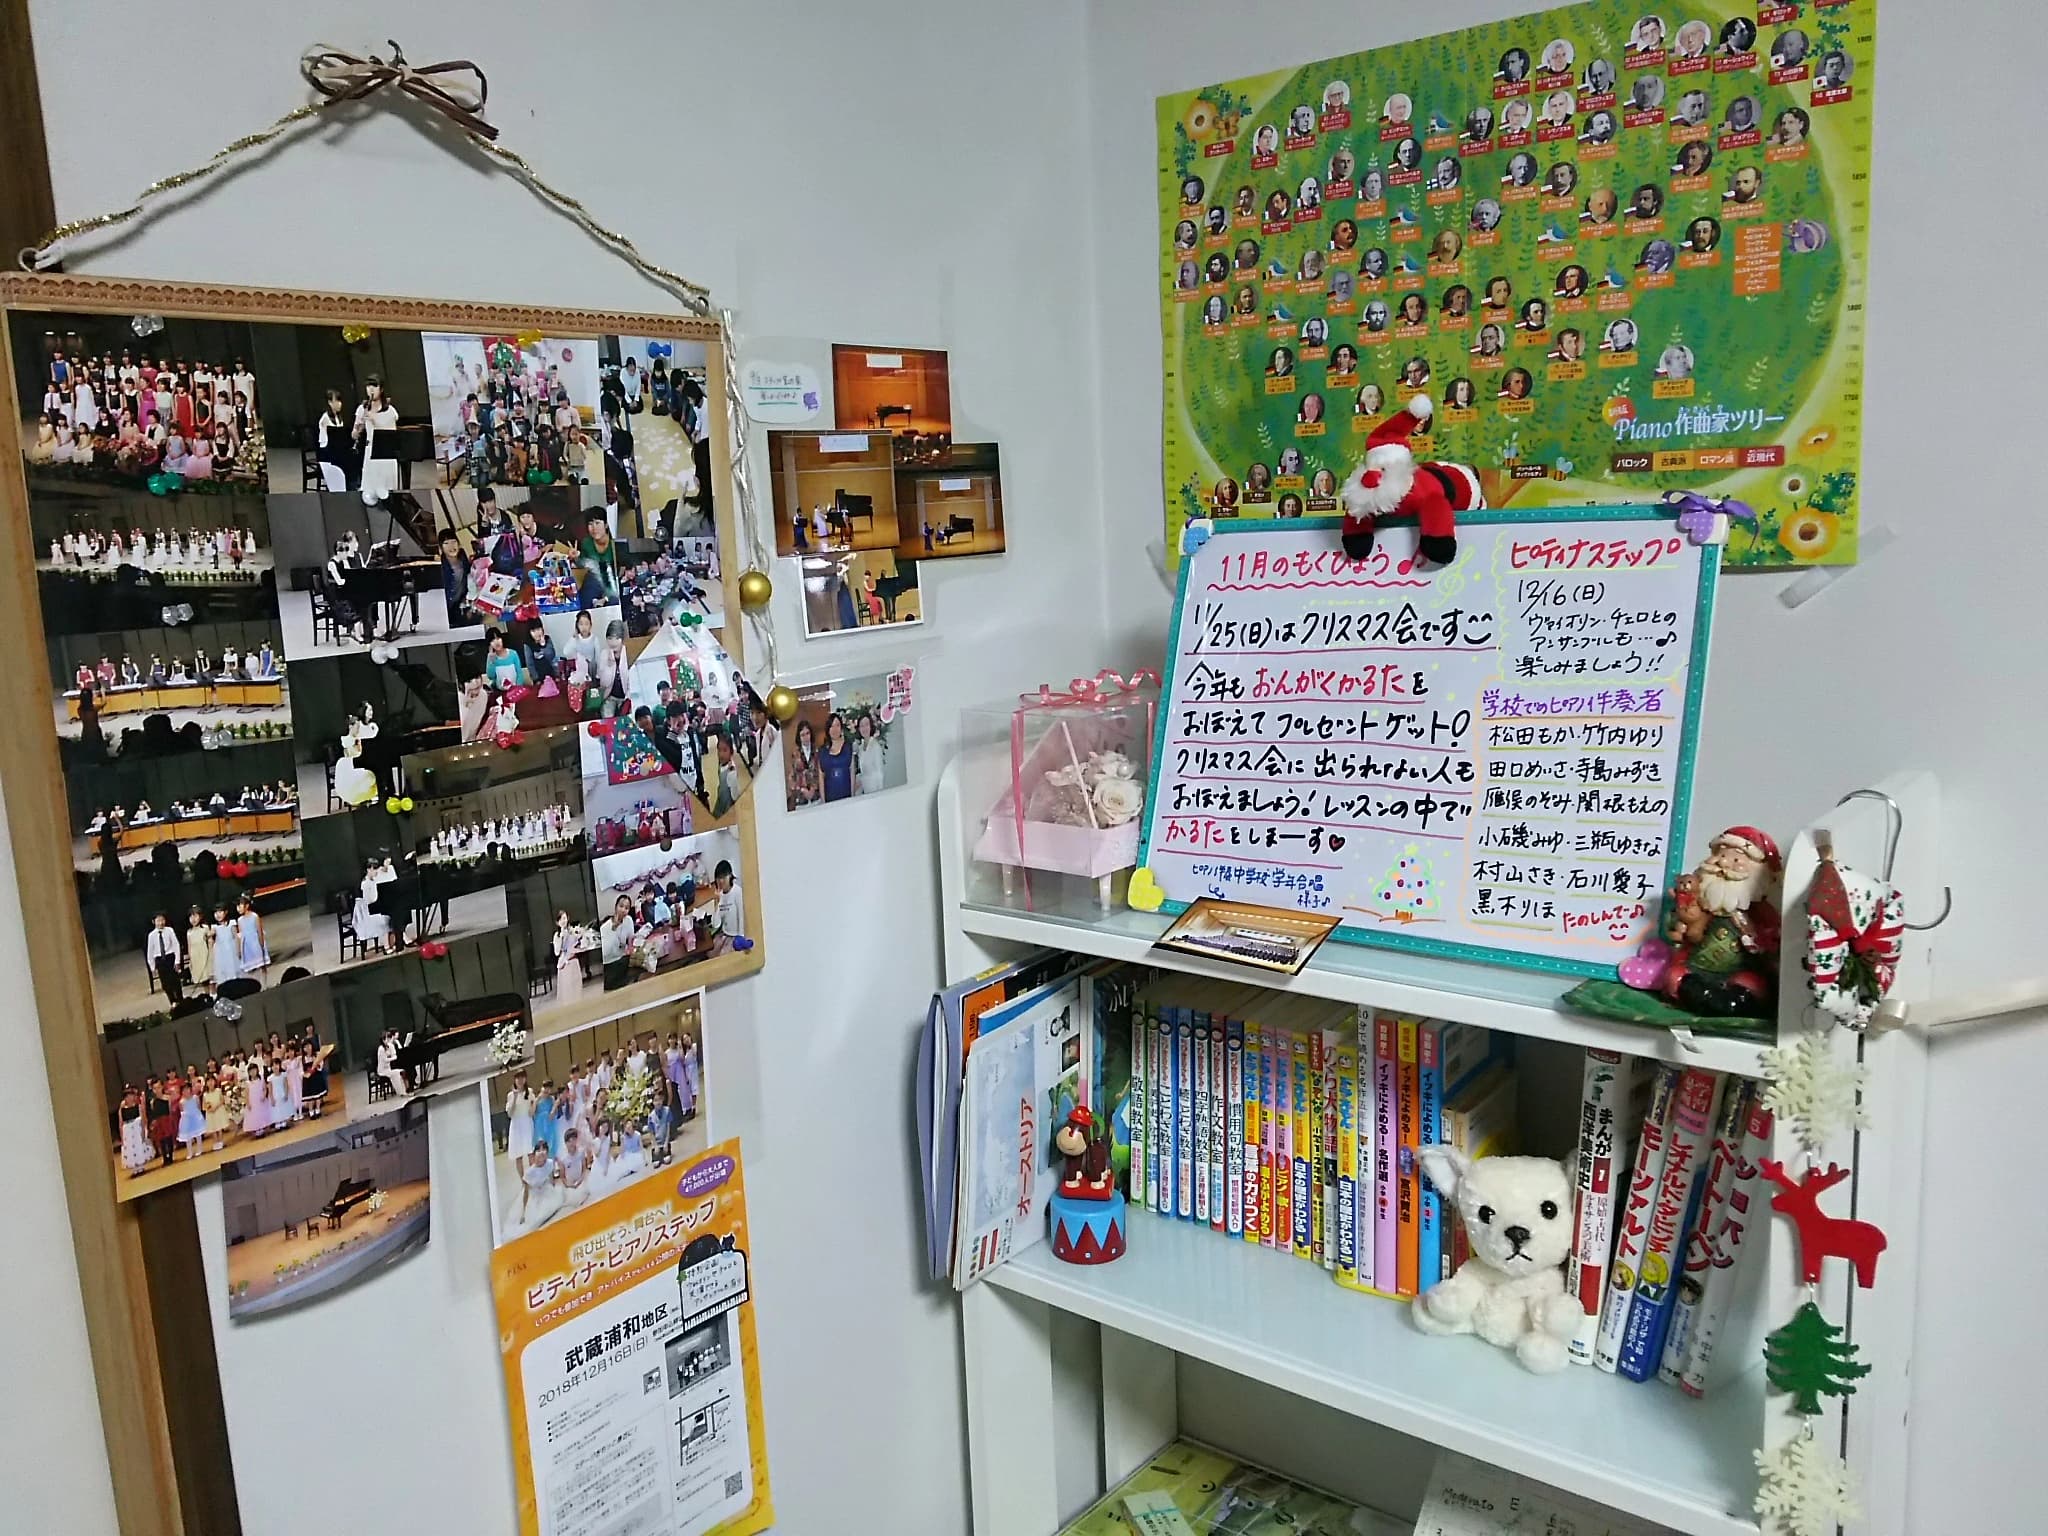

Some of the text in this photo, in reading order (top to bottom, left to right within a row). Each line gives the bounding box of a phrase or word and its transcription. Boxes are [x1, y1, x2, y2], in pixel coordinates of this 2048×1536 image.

[1614, 409, 1785, 441] Piano 作曲家ツリー
[1616, 458, 1648, 468] バロック
[1510, 537, 1681, 570] ピティナステップ
[1482, 689, 1664, 718] 学校でのピアノ伴奏者
[1131, 1074, 1144, 1142] 敬語教室
[1211, 1095, 1225, 1164] 作文教室
[1229, 1103, 1243, 1175] 慣用句教室
[1378, 1063, 1389, 1145] イッキによめる!
[1594, 1107, 1614, 1157] まんが
[1017, 1096, 1034, 1217] オーストリア
[1577, 1101, 1597, 1190] 西洋美術史
[1598, 1169, 1605, 1182] 1
[1618, 1119, 1664, 1259] モーツァルト
[1685, 1138, 1736, 1272] ベートーベン
[1712, 1155, 1758, 1269] ショパン
[527, 1199, 716, 1310] ピティナ・ピアノステップ
[564, 1302, 670, 1374] 武蔵浦和地区
